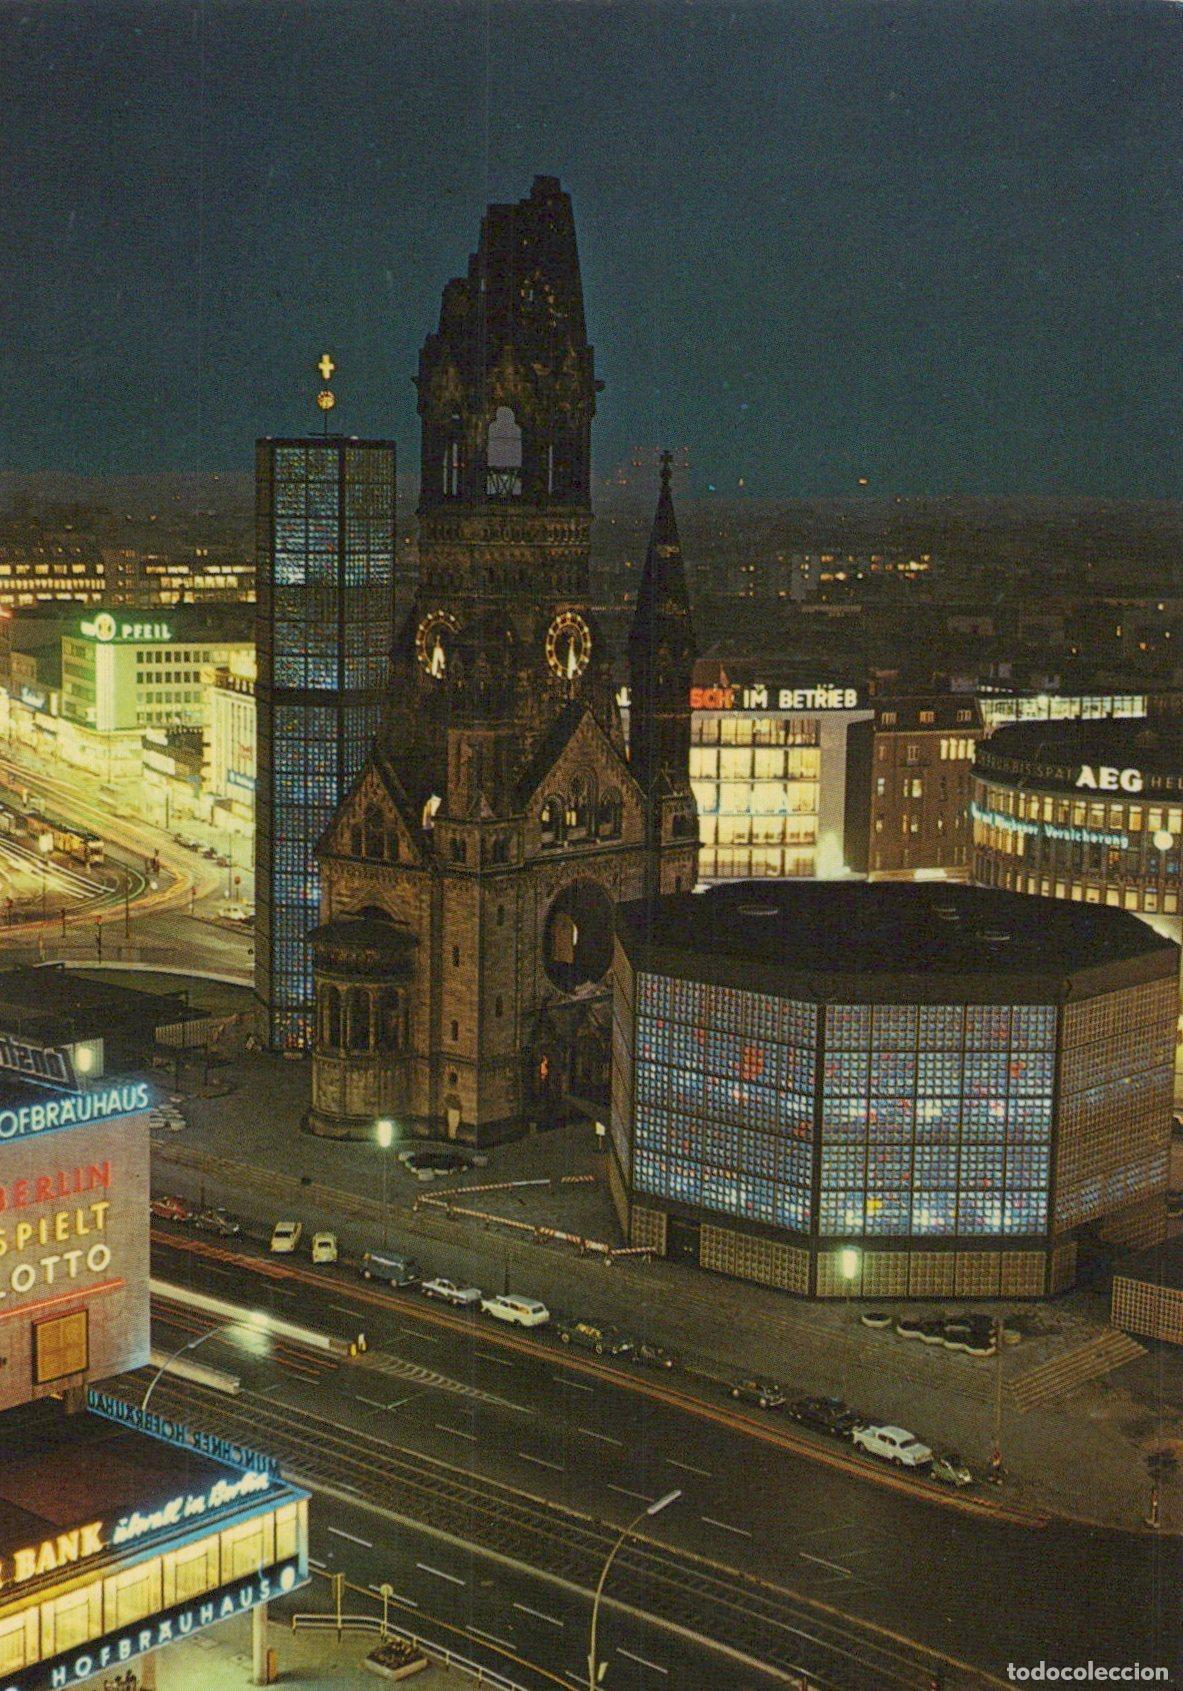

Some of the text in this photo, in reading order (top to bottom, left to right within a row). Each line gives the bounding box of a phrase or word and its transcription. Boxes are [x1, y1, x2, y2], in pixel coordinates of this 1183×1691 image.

[743, 688, 768, 709] IM
[778, 688, 858, 709] BETRIEB
[1075, 764, 1144, 793] AEG
[0, 1082, 149, 1138] OFBRÄUHAUS
[0, 1242, 111, 1298] OTTO
[12, 1521, 104, 1582] BANK
[51, 1579, 271, 1689] HOFBRÄUHAUS
